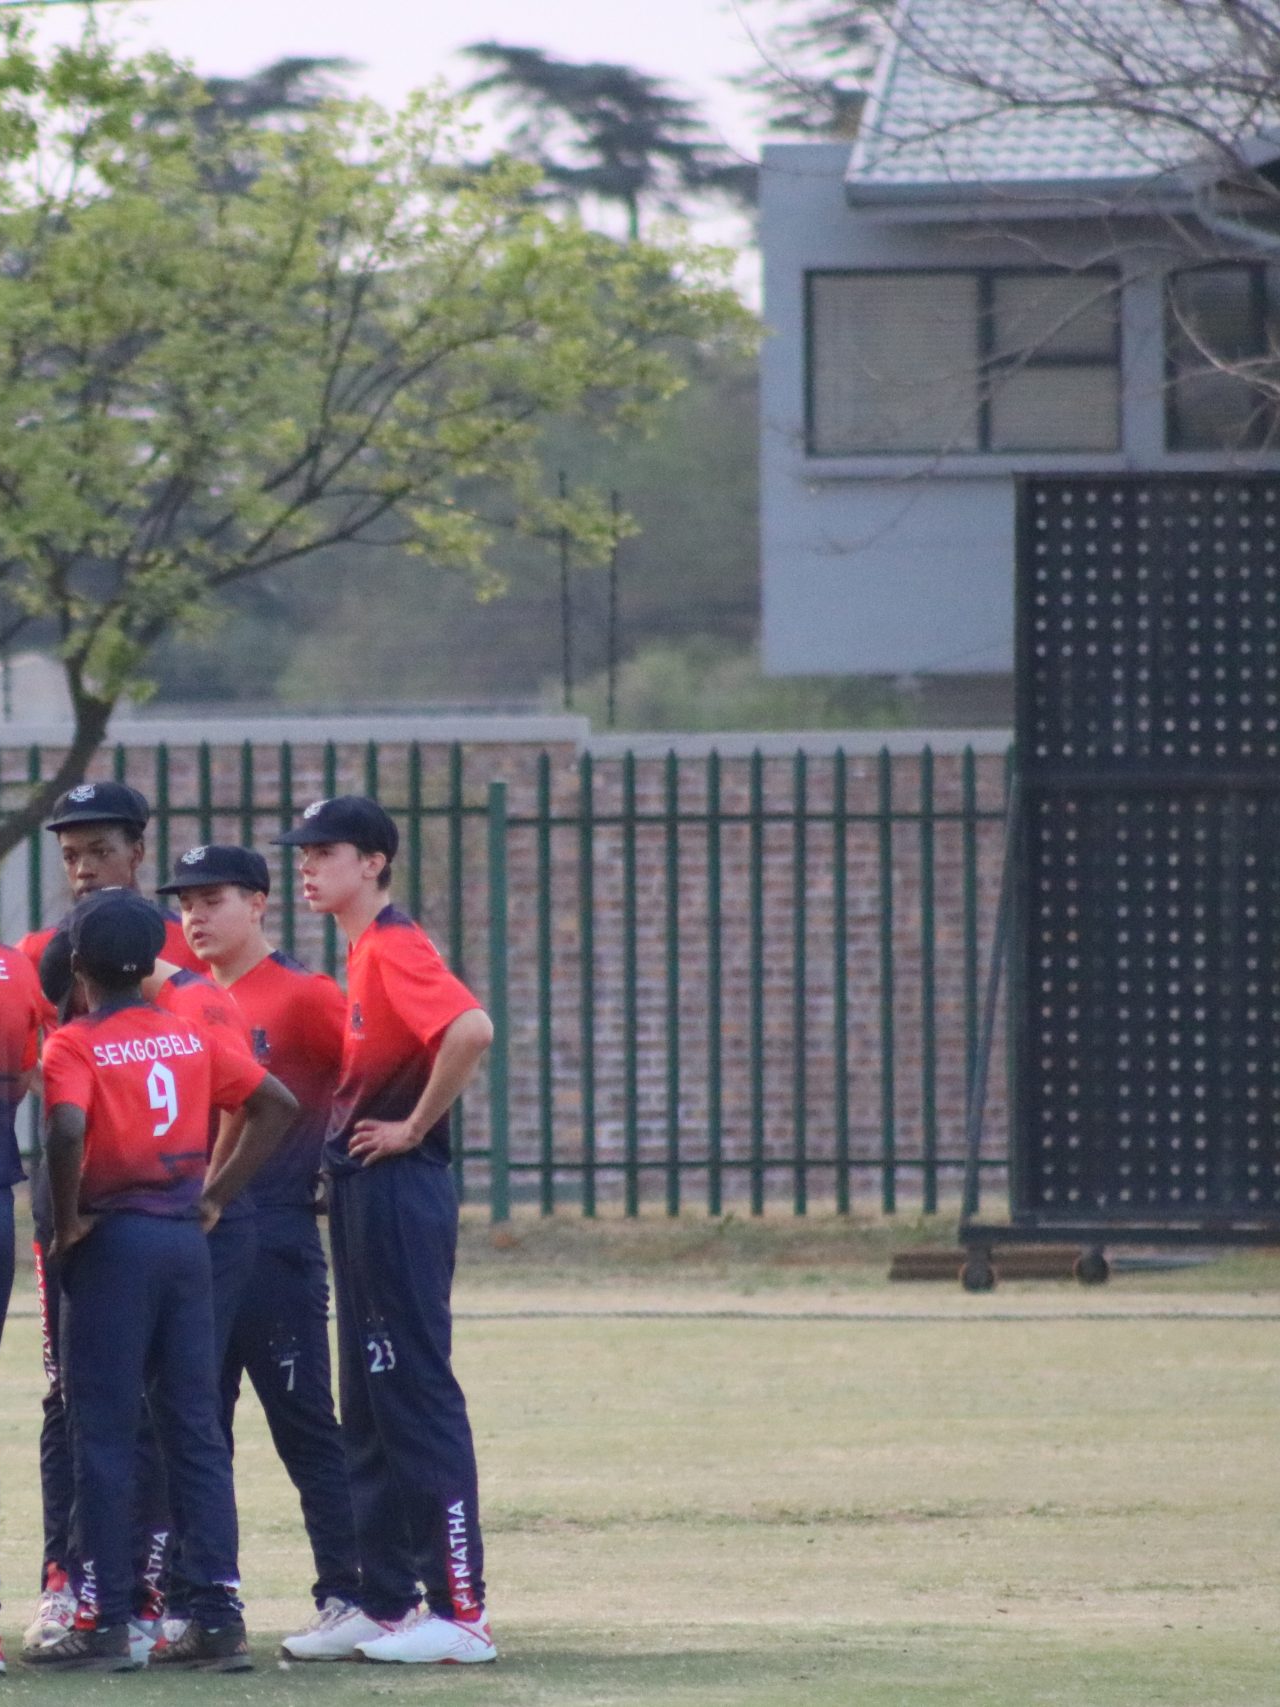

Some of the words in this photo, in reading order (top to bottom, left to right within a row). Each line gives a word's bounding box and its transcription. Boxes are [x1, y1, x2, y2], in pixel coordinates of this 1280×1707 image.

[93, 1033, 204, 1067] SEKGOBELA
[146, 1060, 178, 1137] 9
[367, 1339, 397, 1374] 23
[279, 1359, 295, 1392] 7
